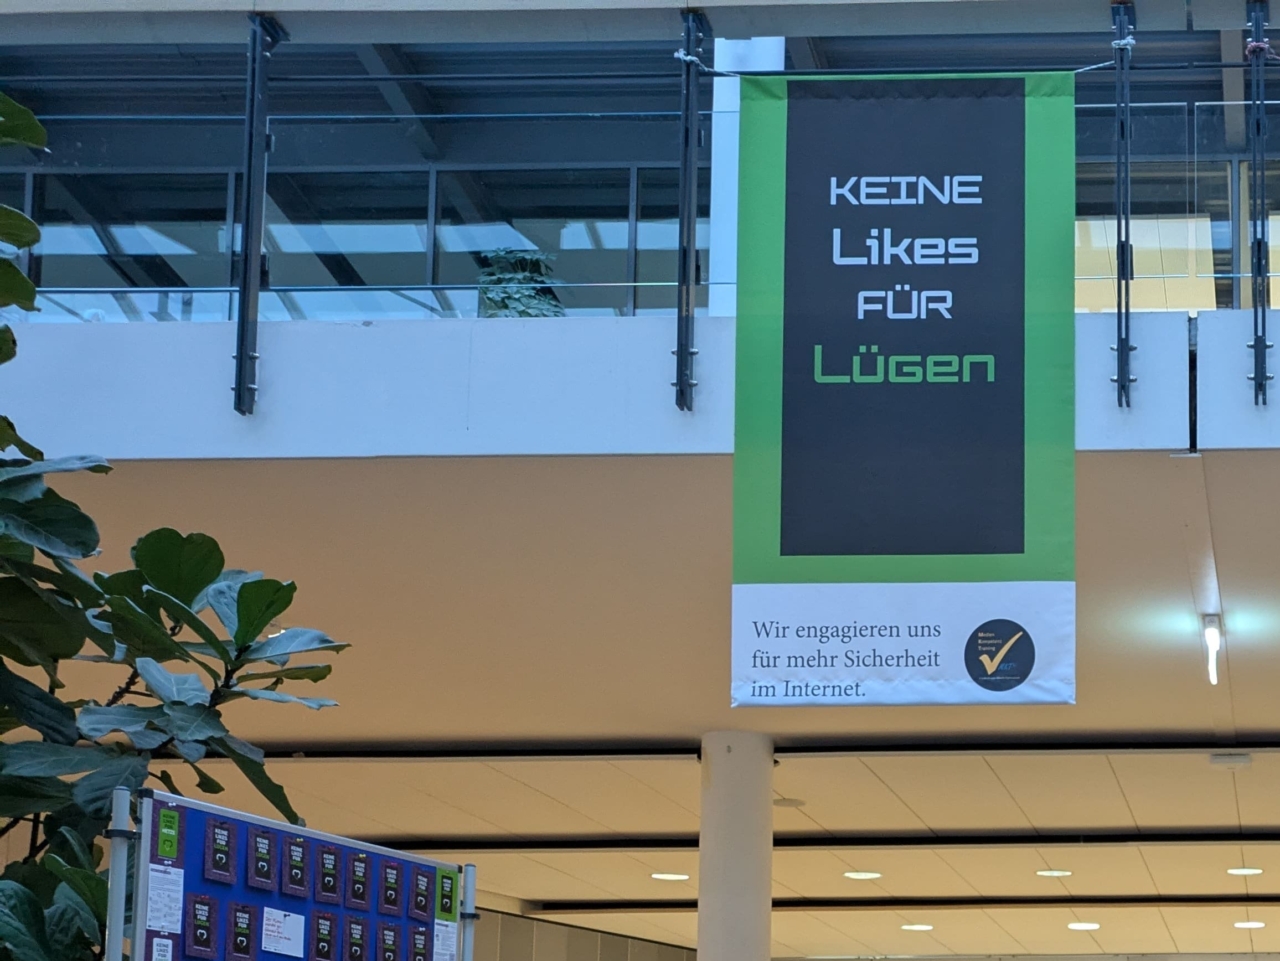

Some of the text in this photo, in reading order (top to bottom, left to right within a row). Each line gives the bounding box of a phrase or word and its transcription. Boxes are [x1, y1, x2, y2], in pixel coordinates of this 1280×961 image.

[830, 175, 982, 205] KEINE
[833, 228, 978, 265] Likes
[857, 284, 952, 319] FÜR
[752, 621, 941, 643] Wir engagieren uns
[752, 649, 940, 668] für mehr Sicherheit
[751, 680, 866, 697] im Internet.
